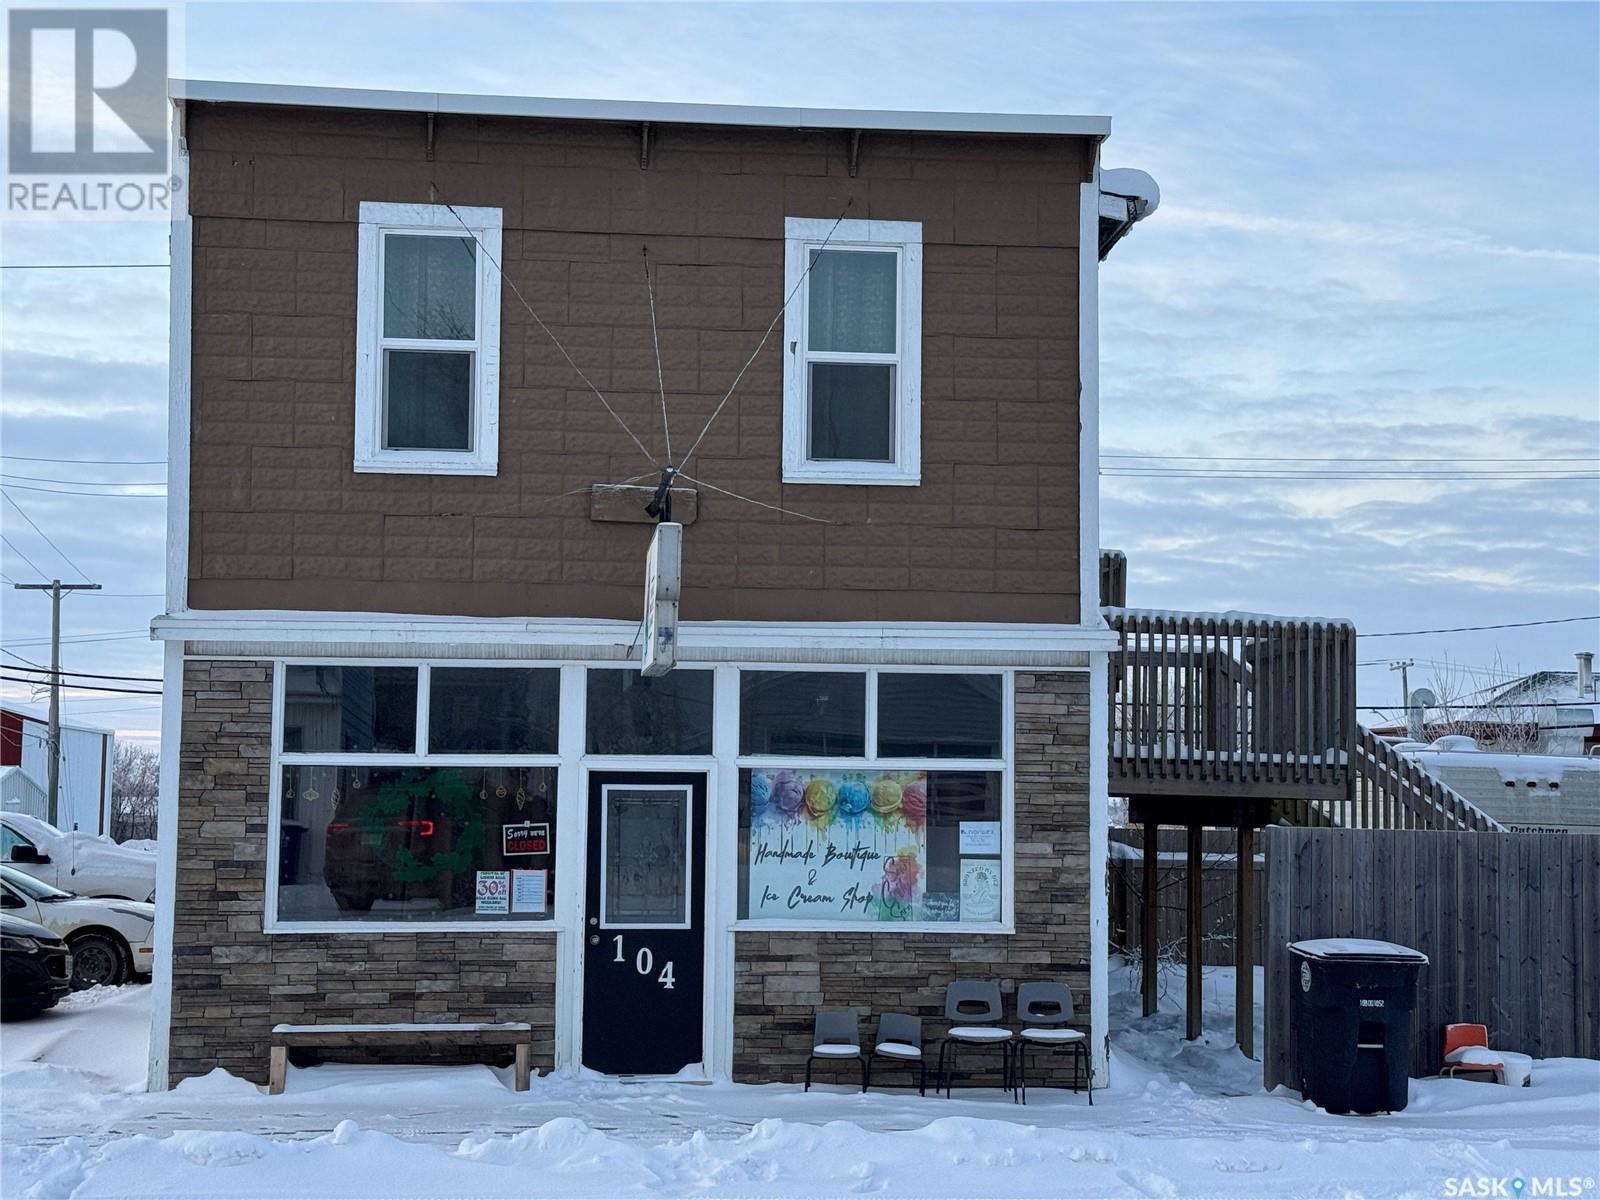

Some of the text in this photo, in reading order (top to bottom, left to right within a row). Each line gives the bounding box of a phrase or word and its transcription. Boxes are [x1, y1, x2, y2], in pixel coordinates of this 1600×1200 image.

[507, 828, 528, 839] Sorry
[508, 839, 546, 852] CLOSED
[754, 840, 881, 872] Handmade Boutique
[807, 868, 818, 886] &
[760, 882, 874, 914] Ice Cream Shop
[612, 934, 676, 990] 104
